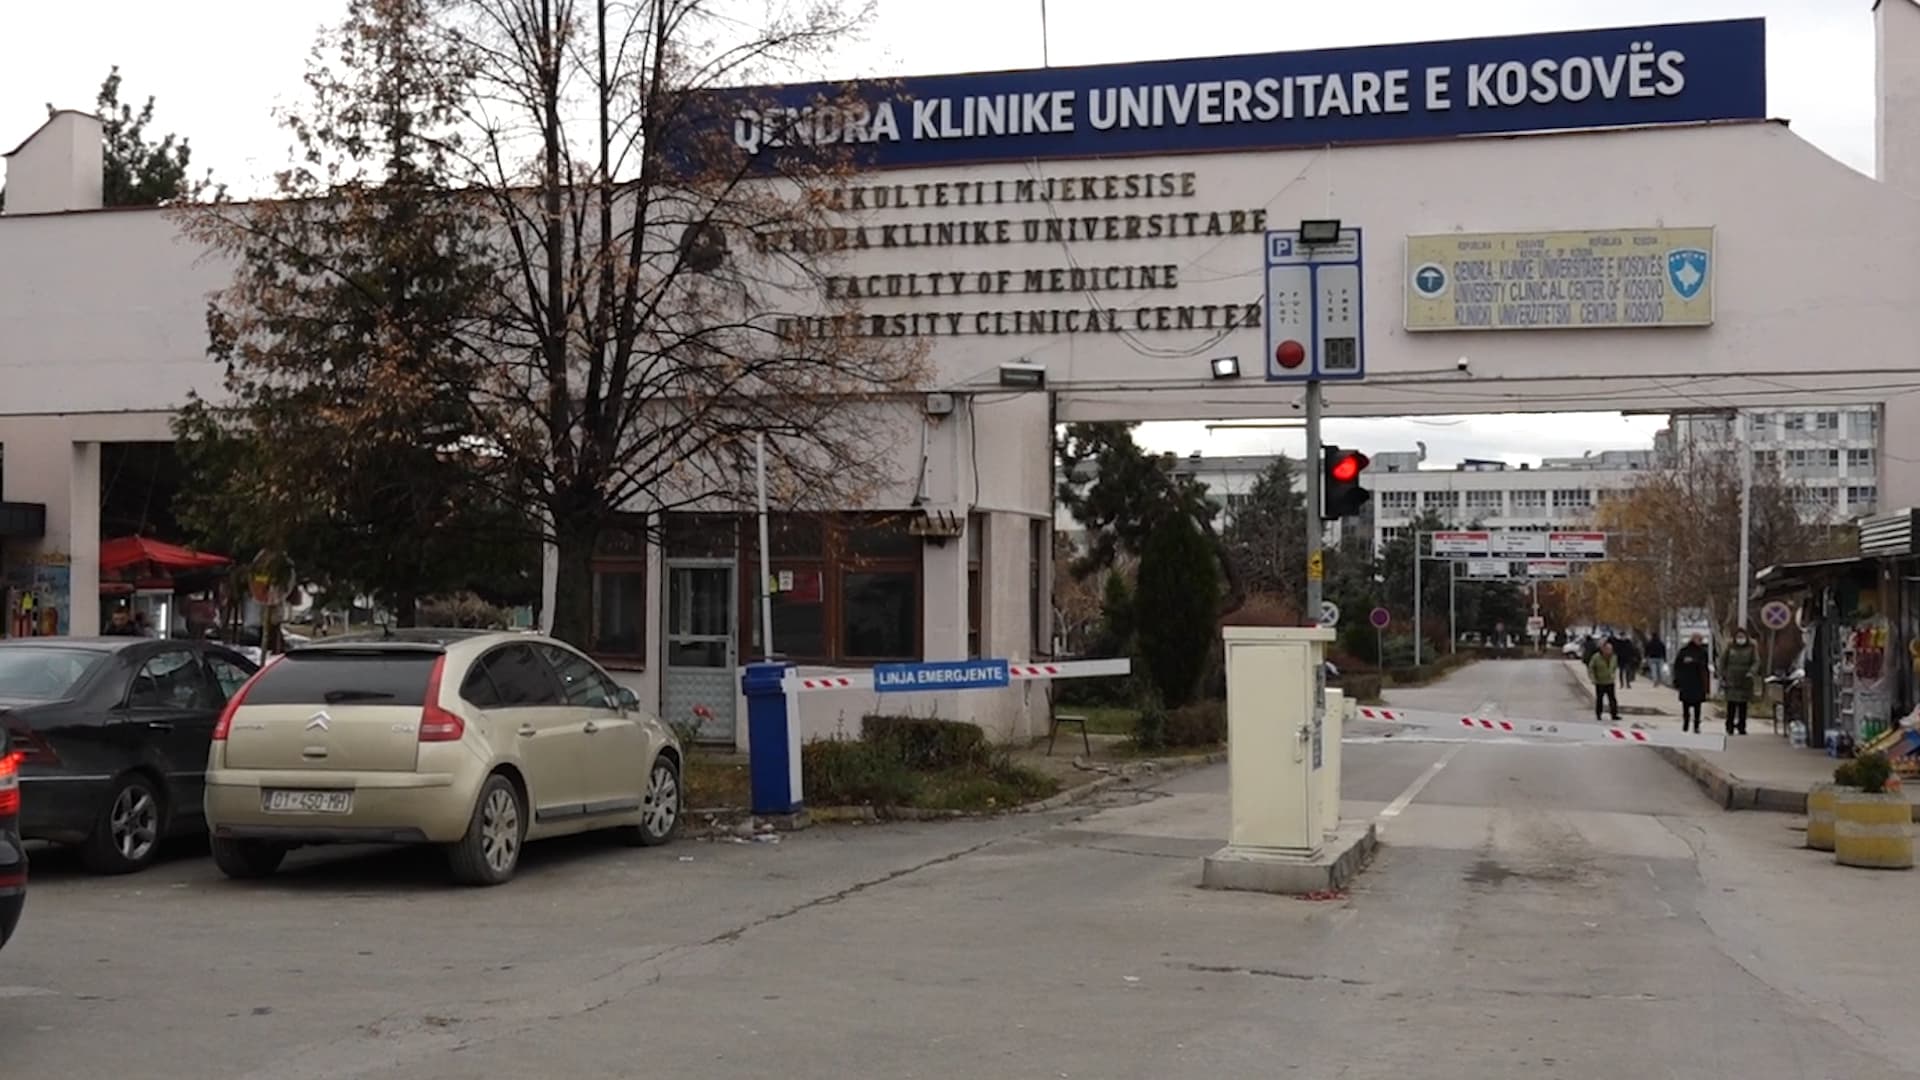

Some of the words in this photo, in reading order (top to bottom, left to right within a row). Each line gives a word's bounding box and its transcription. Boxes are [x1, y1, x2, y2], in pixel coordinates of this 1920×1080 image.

[734, 102, 901, 155] QENDRA
[912, 90, 1075, 140] KLINIKE
[1088, 70, 1409, 129] UNIVERSITARE
[1426, 66, 1450, 110] E
[1467, 41, 1686, 107] KOSOVËS
[814, 182, 984, 211] AKULTETI
[995, 180, 1003, 204] I
[1015, 172, 1197, 204] MJEKESISE
[881, 219, 1011, 249] KLINIKE
[1023, 209, 1268, 243] UNIVERSITARE
[1276, 240, 1288, 256] P
[825, 272, 964, 300] FACULTY
[977, 270, 1012, 295] OF
[1023, 265, 1178, 294] MEDICINE
[1510, 280, 1565, 302] CLINICAL
[1568, 280, 1604, 301] CENTER
[1607, 279, 1620, 301] OF
[1624, 278, 1664, 300] KOSOVO
[975, 308, 1123, 336] CLINICAL
[1136, 303, 1262, 331] CENTER
[1624, 301, 1664, 323] KOSOVO
[880, 671, 915, 686] LINJA
[918, 667, 1003, 684] EMERGJENTE
